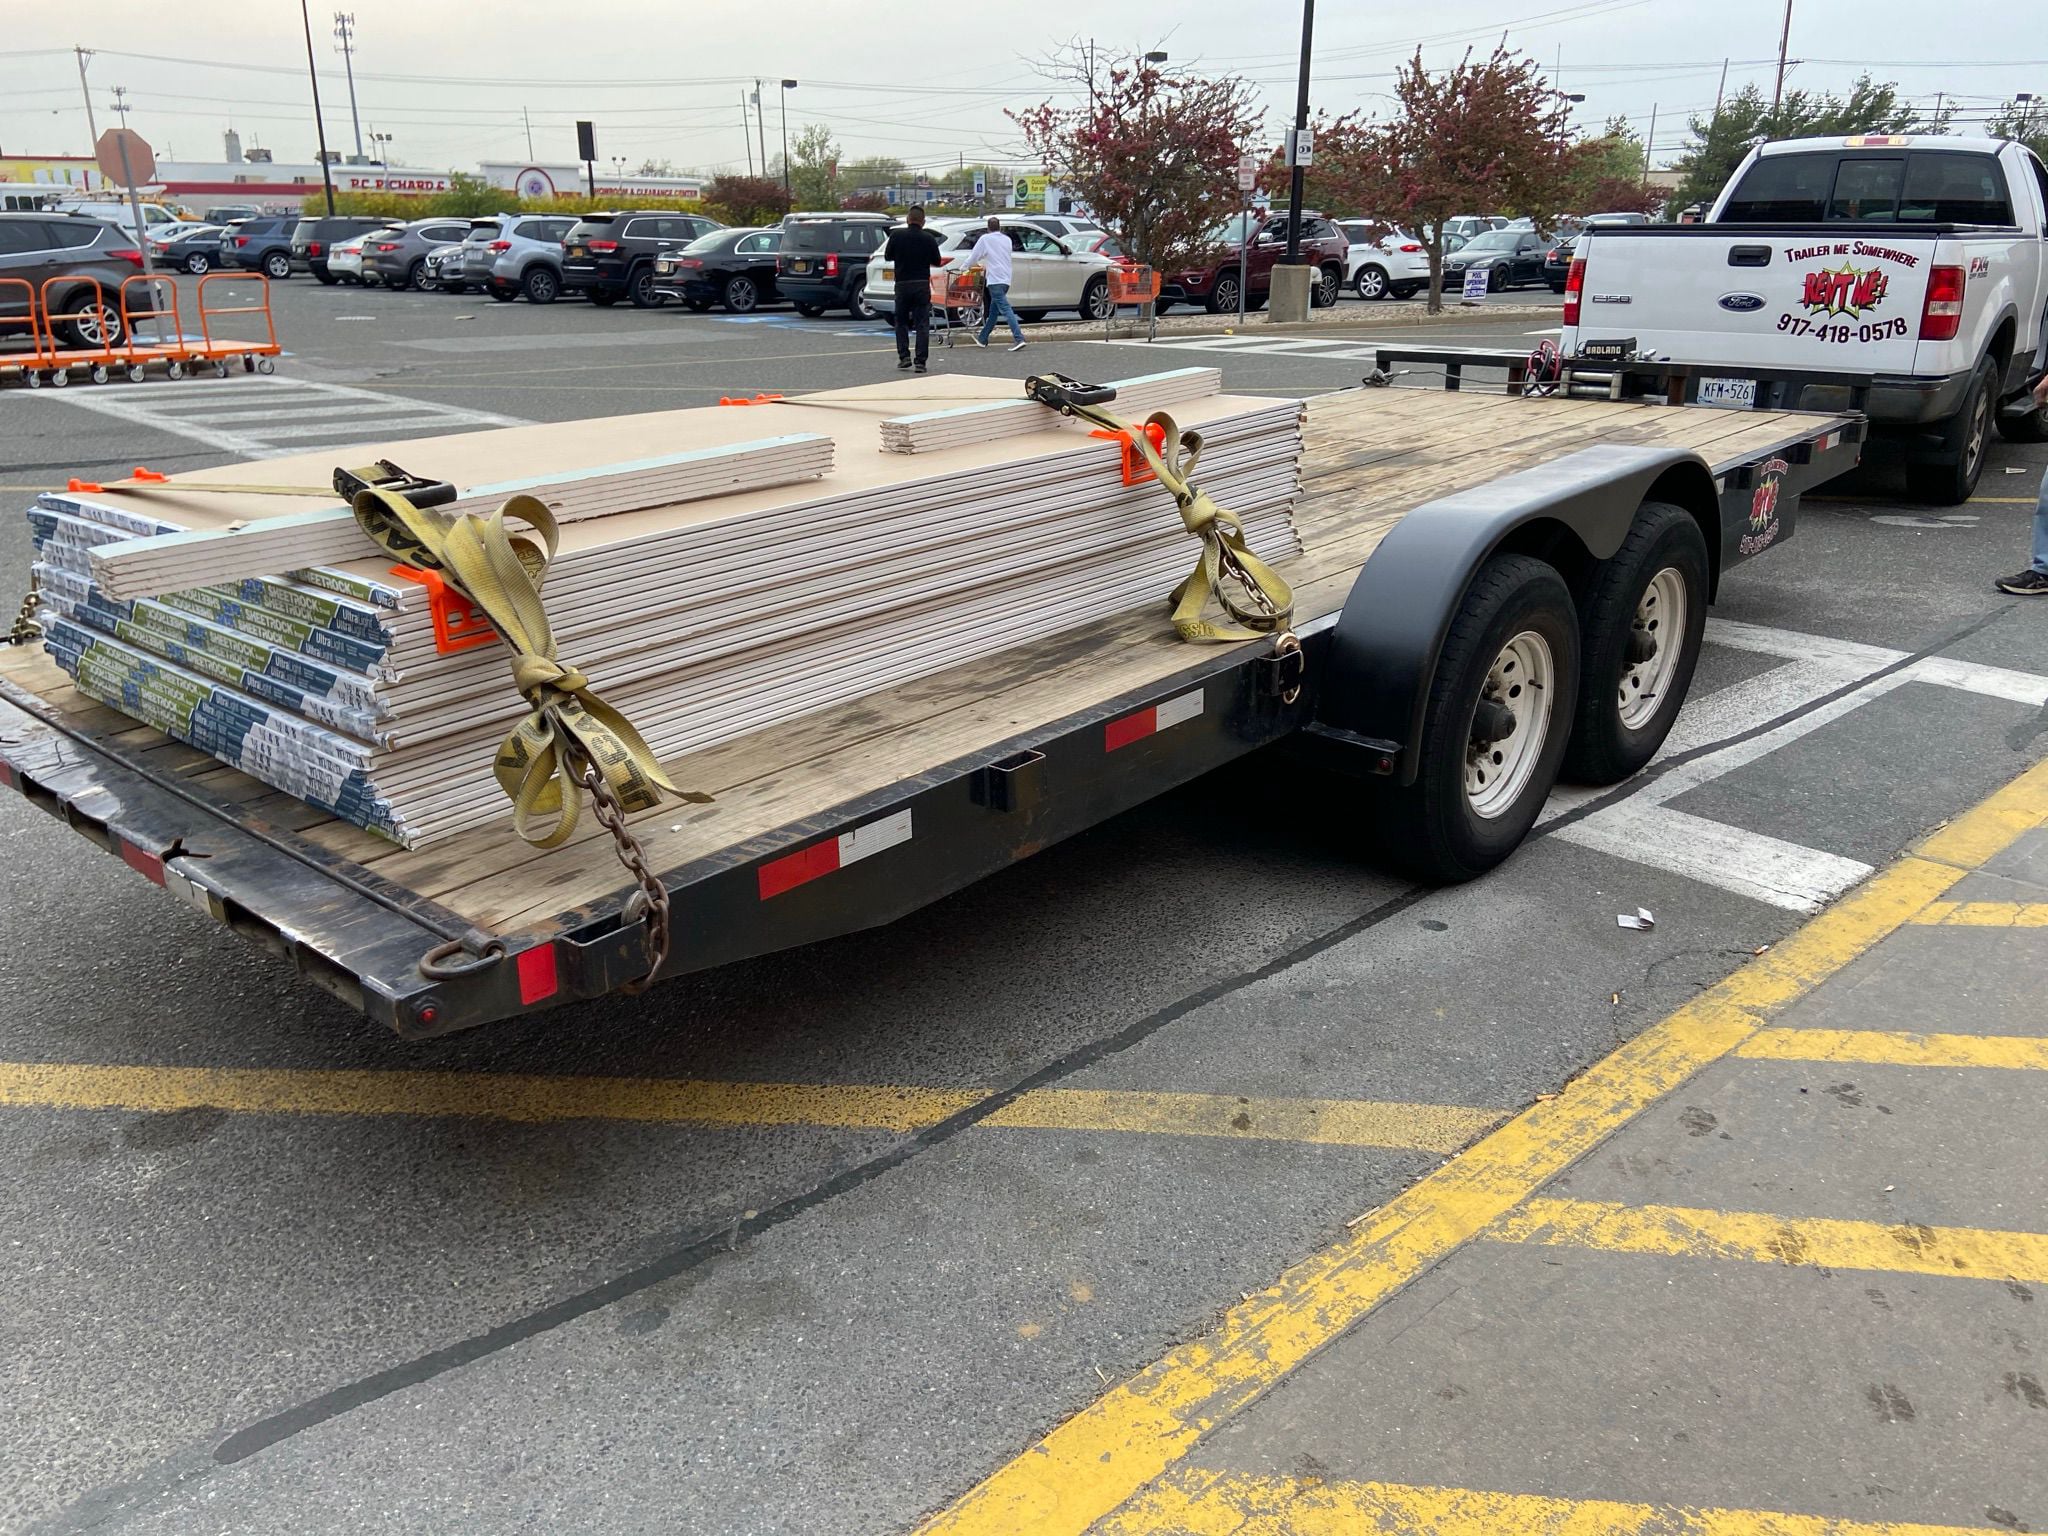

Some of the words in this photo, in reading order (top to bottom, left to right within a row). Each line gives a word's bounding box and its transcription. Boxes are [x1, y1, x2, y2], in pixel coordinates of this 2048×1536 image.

[376, 179, 433, 191] RCHARD
[1784, 245, 1830, 263] TRAILER
[1853, 241, 1919, 268] SOMEWHERE
[1970, 256, 1990, 273] FX4
[1803, 272, 1855, 309] RENT
[1727, 296, 1755, 308] Ford
[1777, 313, 1908, 344] 917-418-0578
[1586, 345, 1622, 355] BADLAND
[246, 610, 294, 635] SHEETROCK
